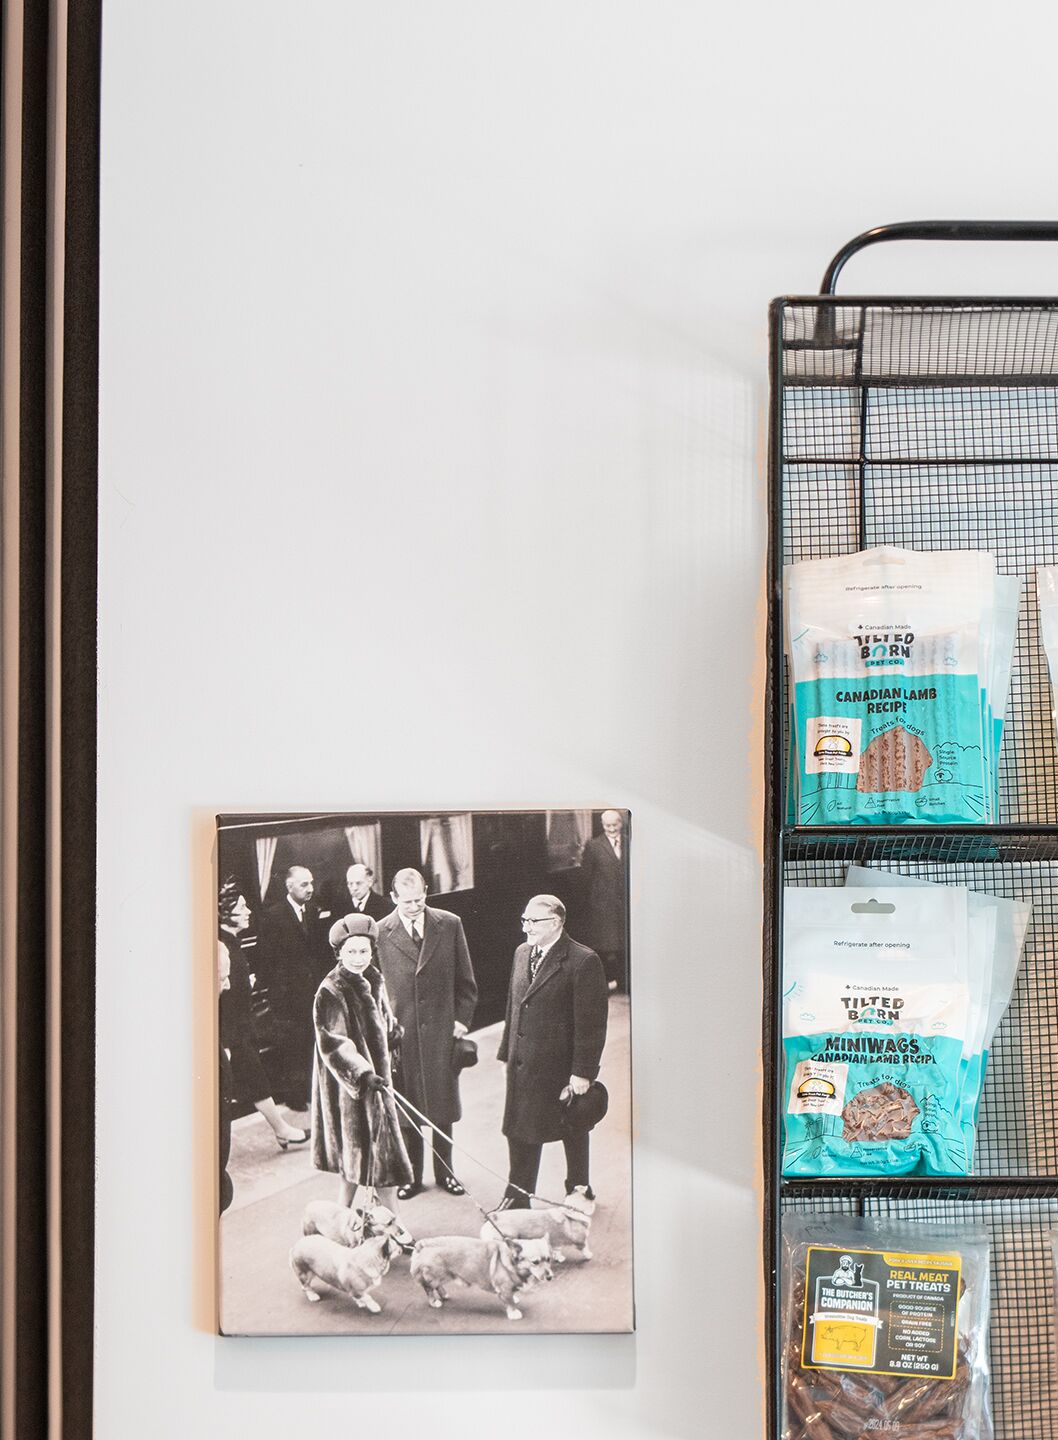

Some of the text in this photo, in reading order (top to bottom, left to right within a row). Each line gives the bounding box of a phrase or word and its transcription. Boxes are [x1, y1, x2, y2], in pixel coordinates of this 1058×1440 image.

[835, 687, 937, 703] CANADIAN LAMB
[867, 701, 907, 714] RECIPE
[870, 717, 925, 736] Treats for dogs
[840, 996, 905, 1010] TILTED
[825, 1037, 919, 1054] MINIWAGS
[811, 1053, 899, 1064] CANADIAN LAMB
[857, 1076, 880, 1088] Treats
[889, 1270, 949, 1283] REAL MEAT
[886, 1280, 951, 1293] PET TREATS
[821, 1287, 873, 1300] THE BUTCHER'S
[820, 1297, 873, 1311] COMPANION
[909, 1310, 933, 1318] PROTEIN
[901, 1319, 918, 1327] GRAIN
[902, 1361, 912, 1369] OZ
